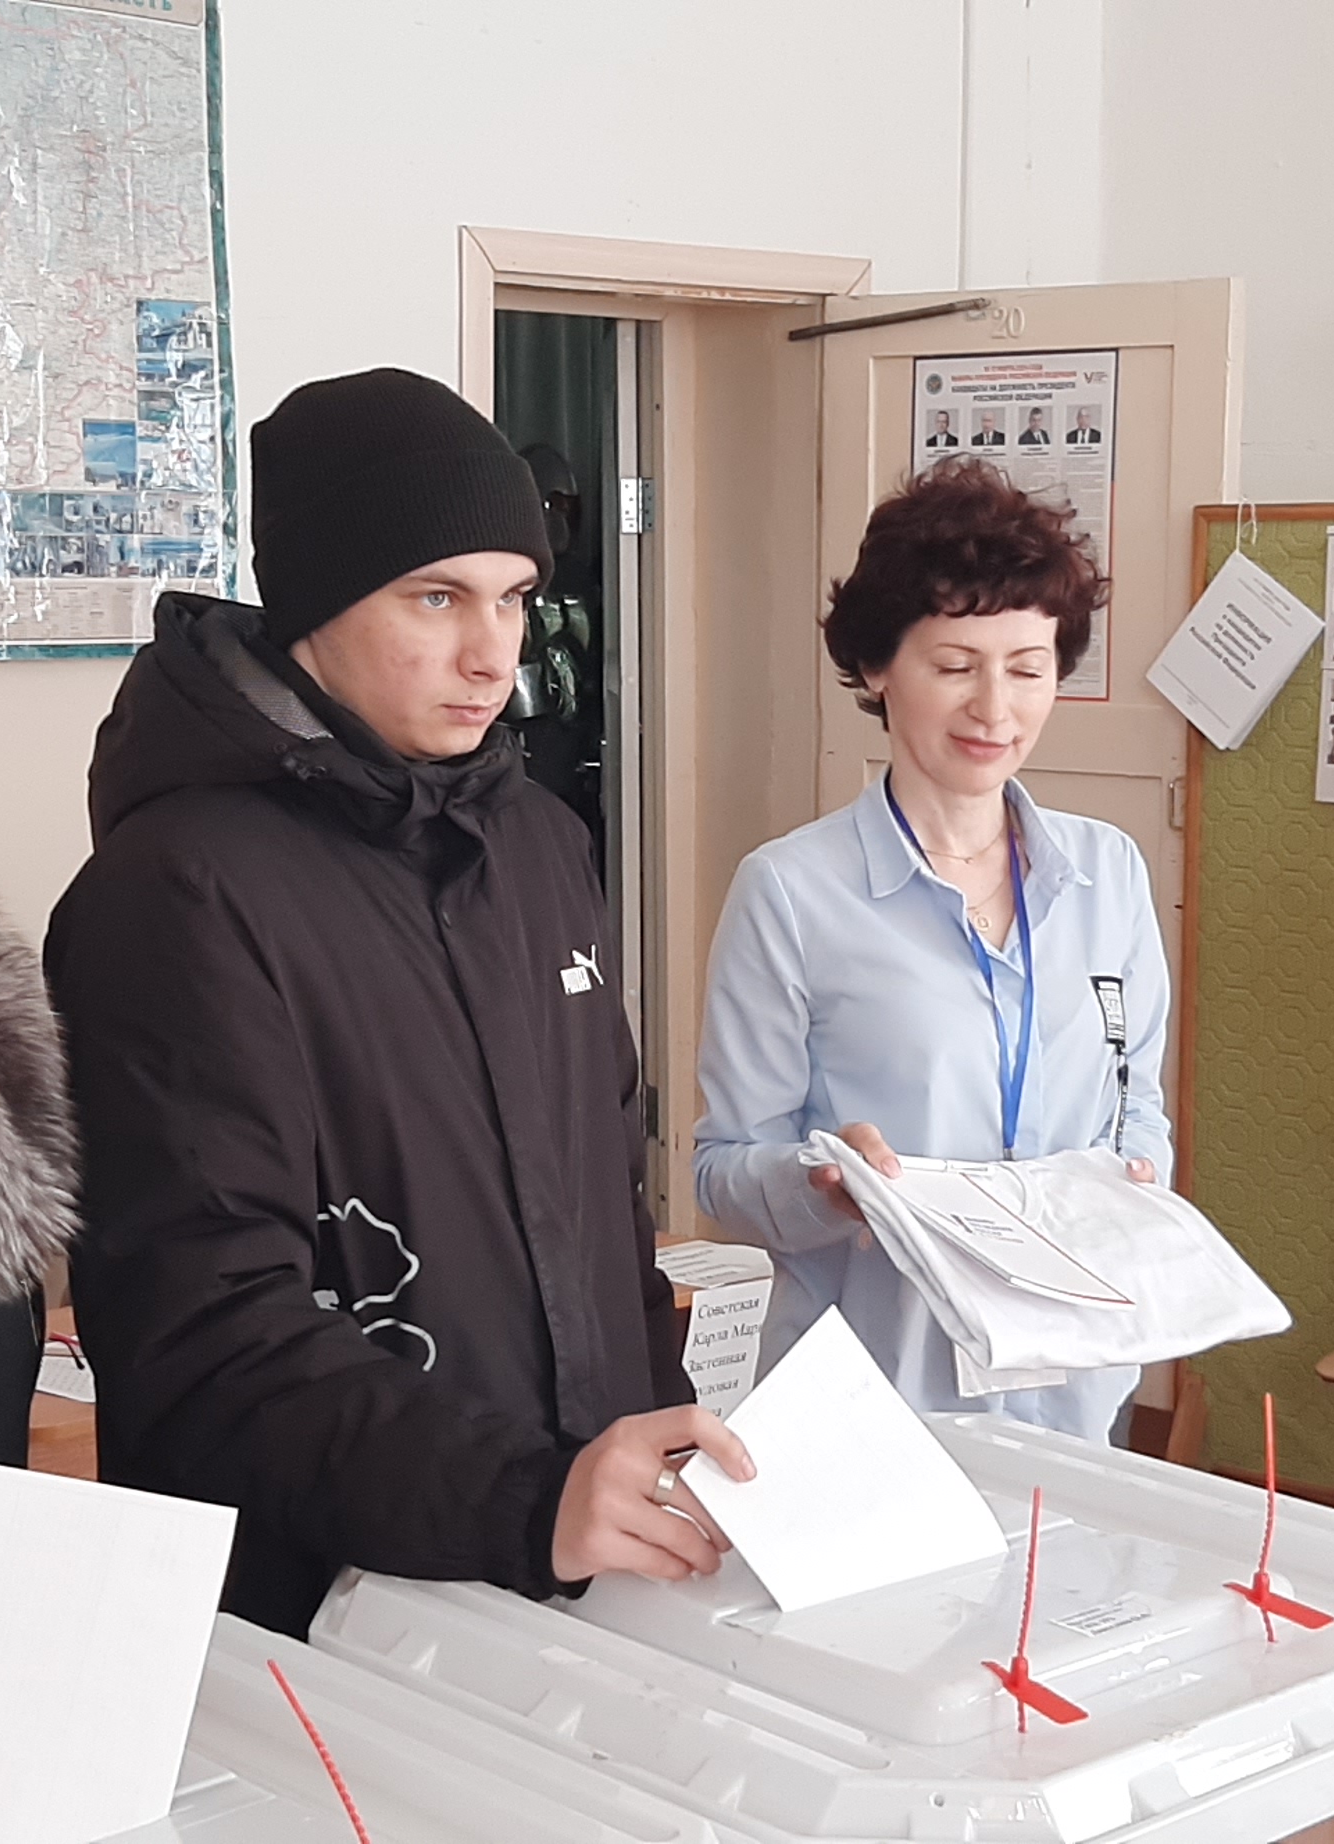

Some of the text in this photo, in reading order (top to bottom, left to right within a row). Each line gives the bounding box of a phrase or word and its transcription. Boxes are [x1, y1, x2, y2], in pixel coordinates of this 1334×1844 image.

[991, 306, 1026, 339] 20
[698, 1298, 760, 1319] Советская
[692, 1329, 729, 1348] Карла
